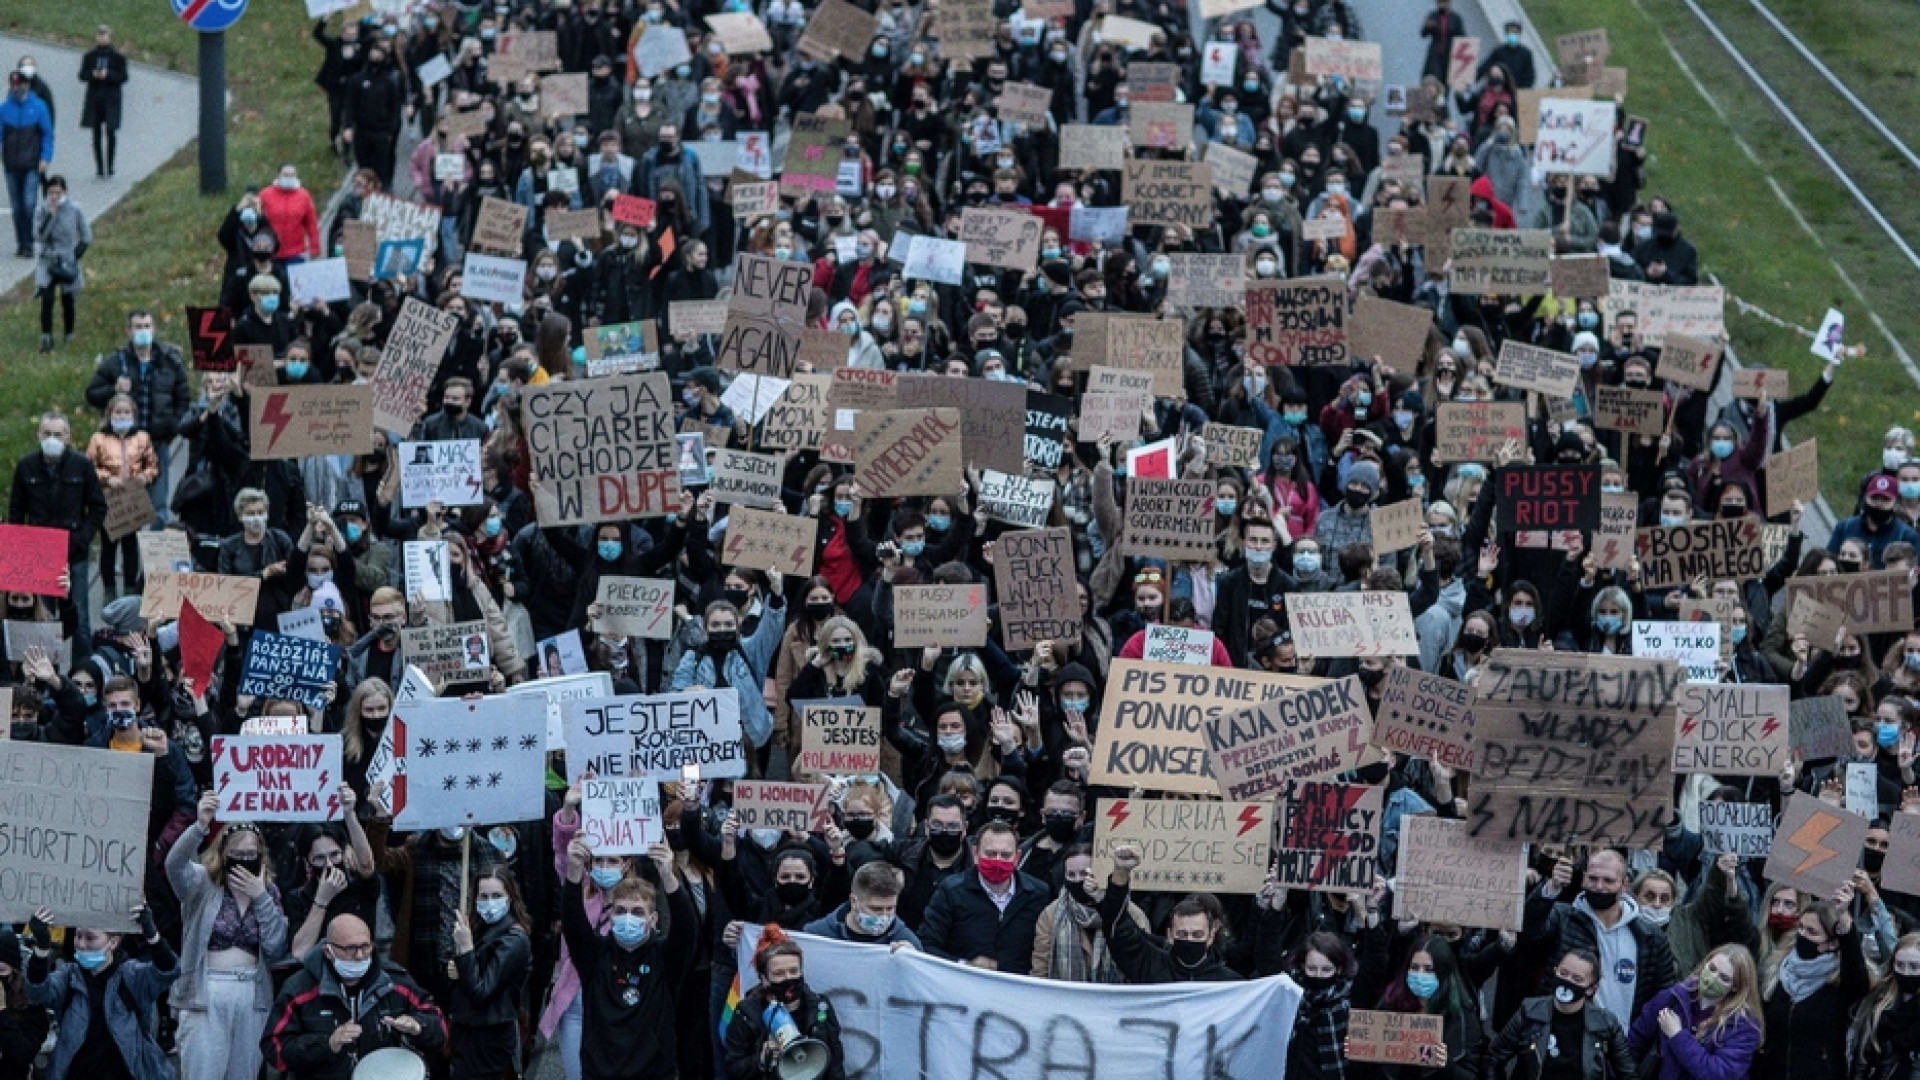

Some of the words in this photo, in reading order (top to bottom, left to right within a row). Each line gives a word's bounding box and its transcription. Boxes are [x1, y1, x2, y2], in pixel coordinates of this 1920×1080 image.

[733, 253, 811, 306] NEVER
[529, 389, 595, 418] CZY
[609, 382, 661, 416] JA
[529, 420, 561, 454] CI
[572, 411, 669, 450] JAREK
[556, 480, 584, 520] W
[1504, 471, 1595, 497] PUSSY
[1130, 498, 1174, 513] ABORT
[1178, 498, 1200, 515] MY
[1516, 499, 1581, 525] RIOT
[1650, 519, 1744, 557] BOSAK
[1642, 557, 1672, 585] MA
[1679, 546, 1763, 582] MAŁEGO
[1008, 578, 1063, 599] WITH
[1643, 636, 1662, 649] TO
[1121, 668, 1167, 694] PIS
[1172, 673, 1211, 696] TO
[1214, 676, 1257, 701] NIE
[585, 696, 718, 736] JESTEM
[805, 708, 840, 728] KTO
[843, 708, 867, 727] TY
[1204, 706, 1277, 755] KAJA
[1278, 678, 1360, 731] GODEK
[1681, 686, 1775, 719] SMALL
[1701, 718, 1758, 742] DICK
[1674, 745, 1779, 770] ENERGY
[735, 784, 754, 800] NO
[71, 796, 110, 828] NO
[735, 807, 758, 824] NO
[1143, 800, 1227, 833] KURWA
[81, 833, 137, 878] DICK
[820, 987, 1261, 1080] STRAJK
